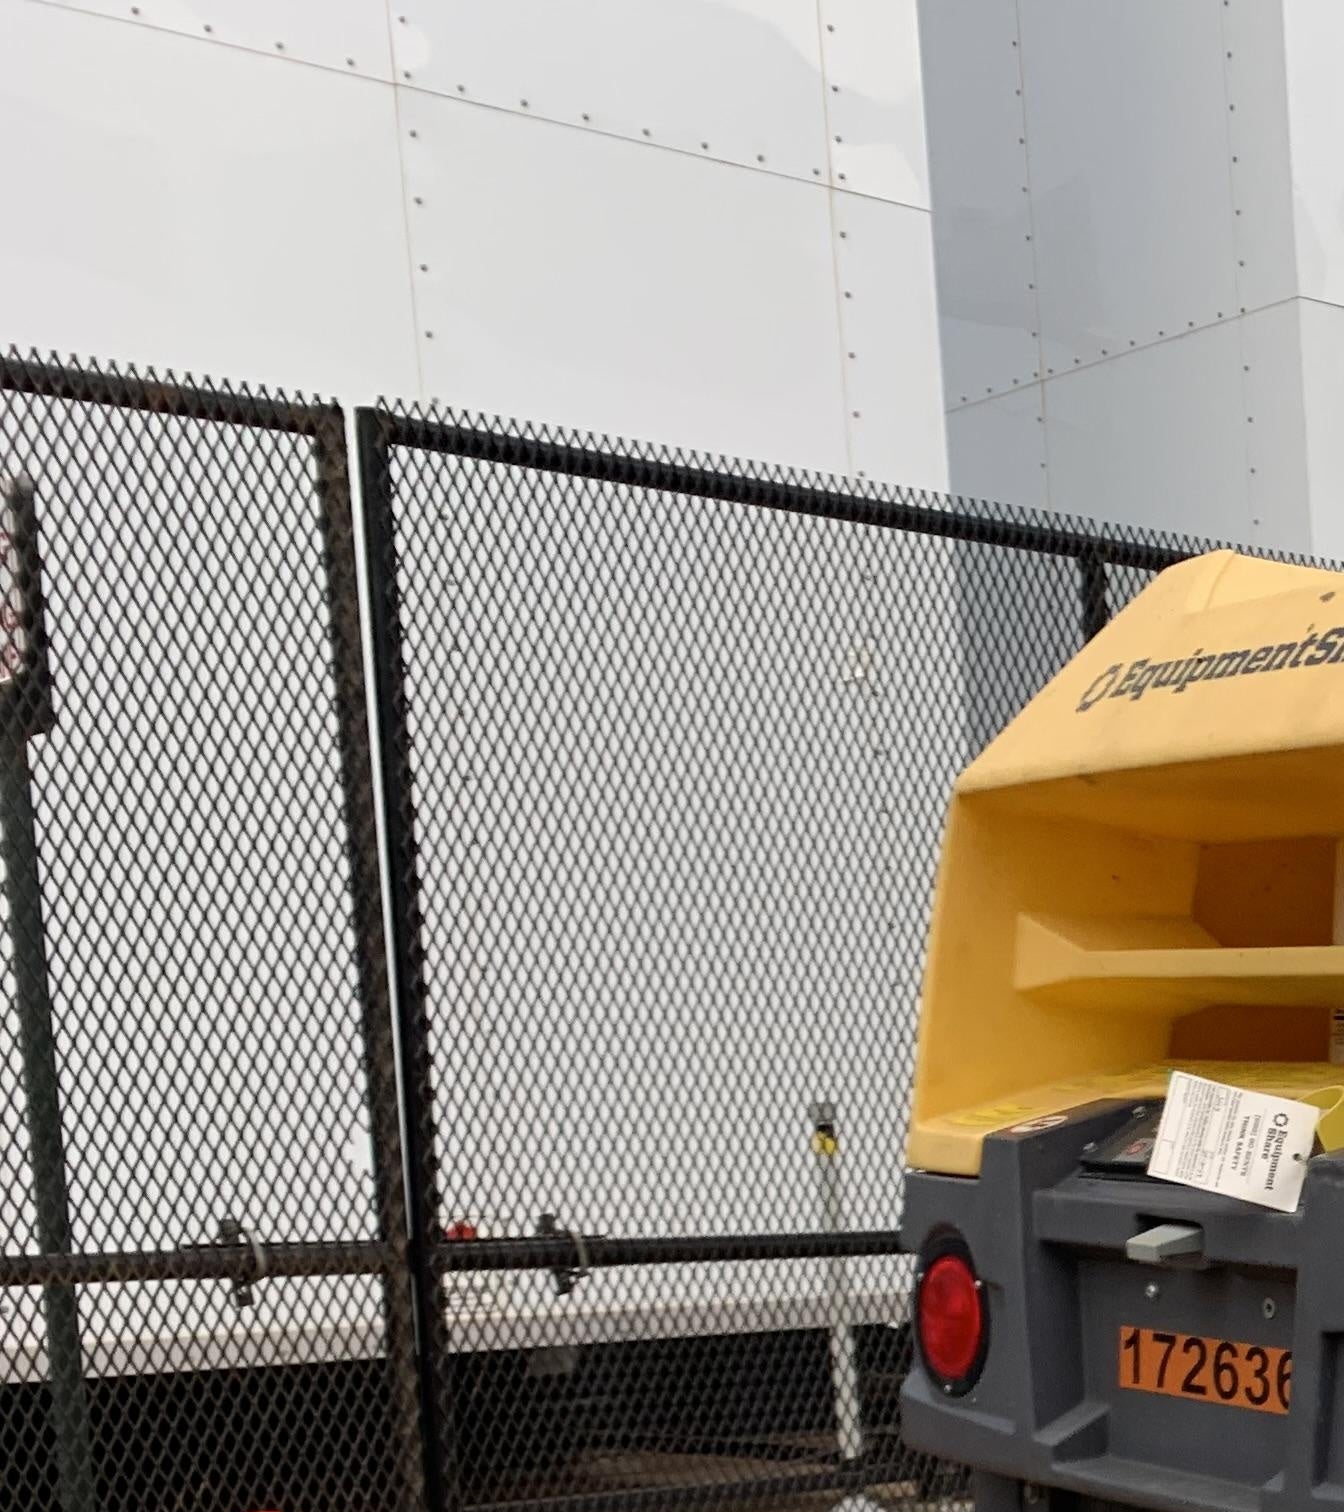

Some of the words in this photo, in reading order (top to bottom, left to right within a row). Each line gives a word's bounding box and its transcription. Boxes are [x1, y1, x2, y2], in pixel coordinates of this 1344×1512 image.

[1261, 1128, 1277, 1160] Share
[1264, 1130, 1288, 1190] Equipment
[1124, 1327, 1292, 1410] 172636
